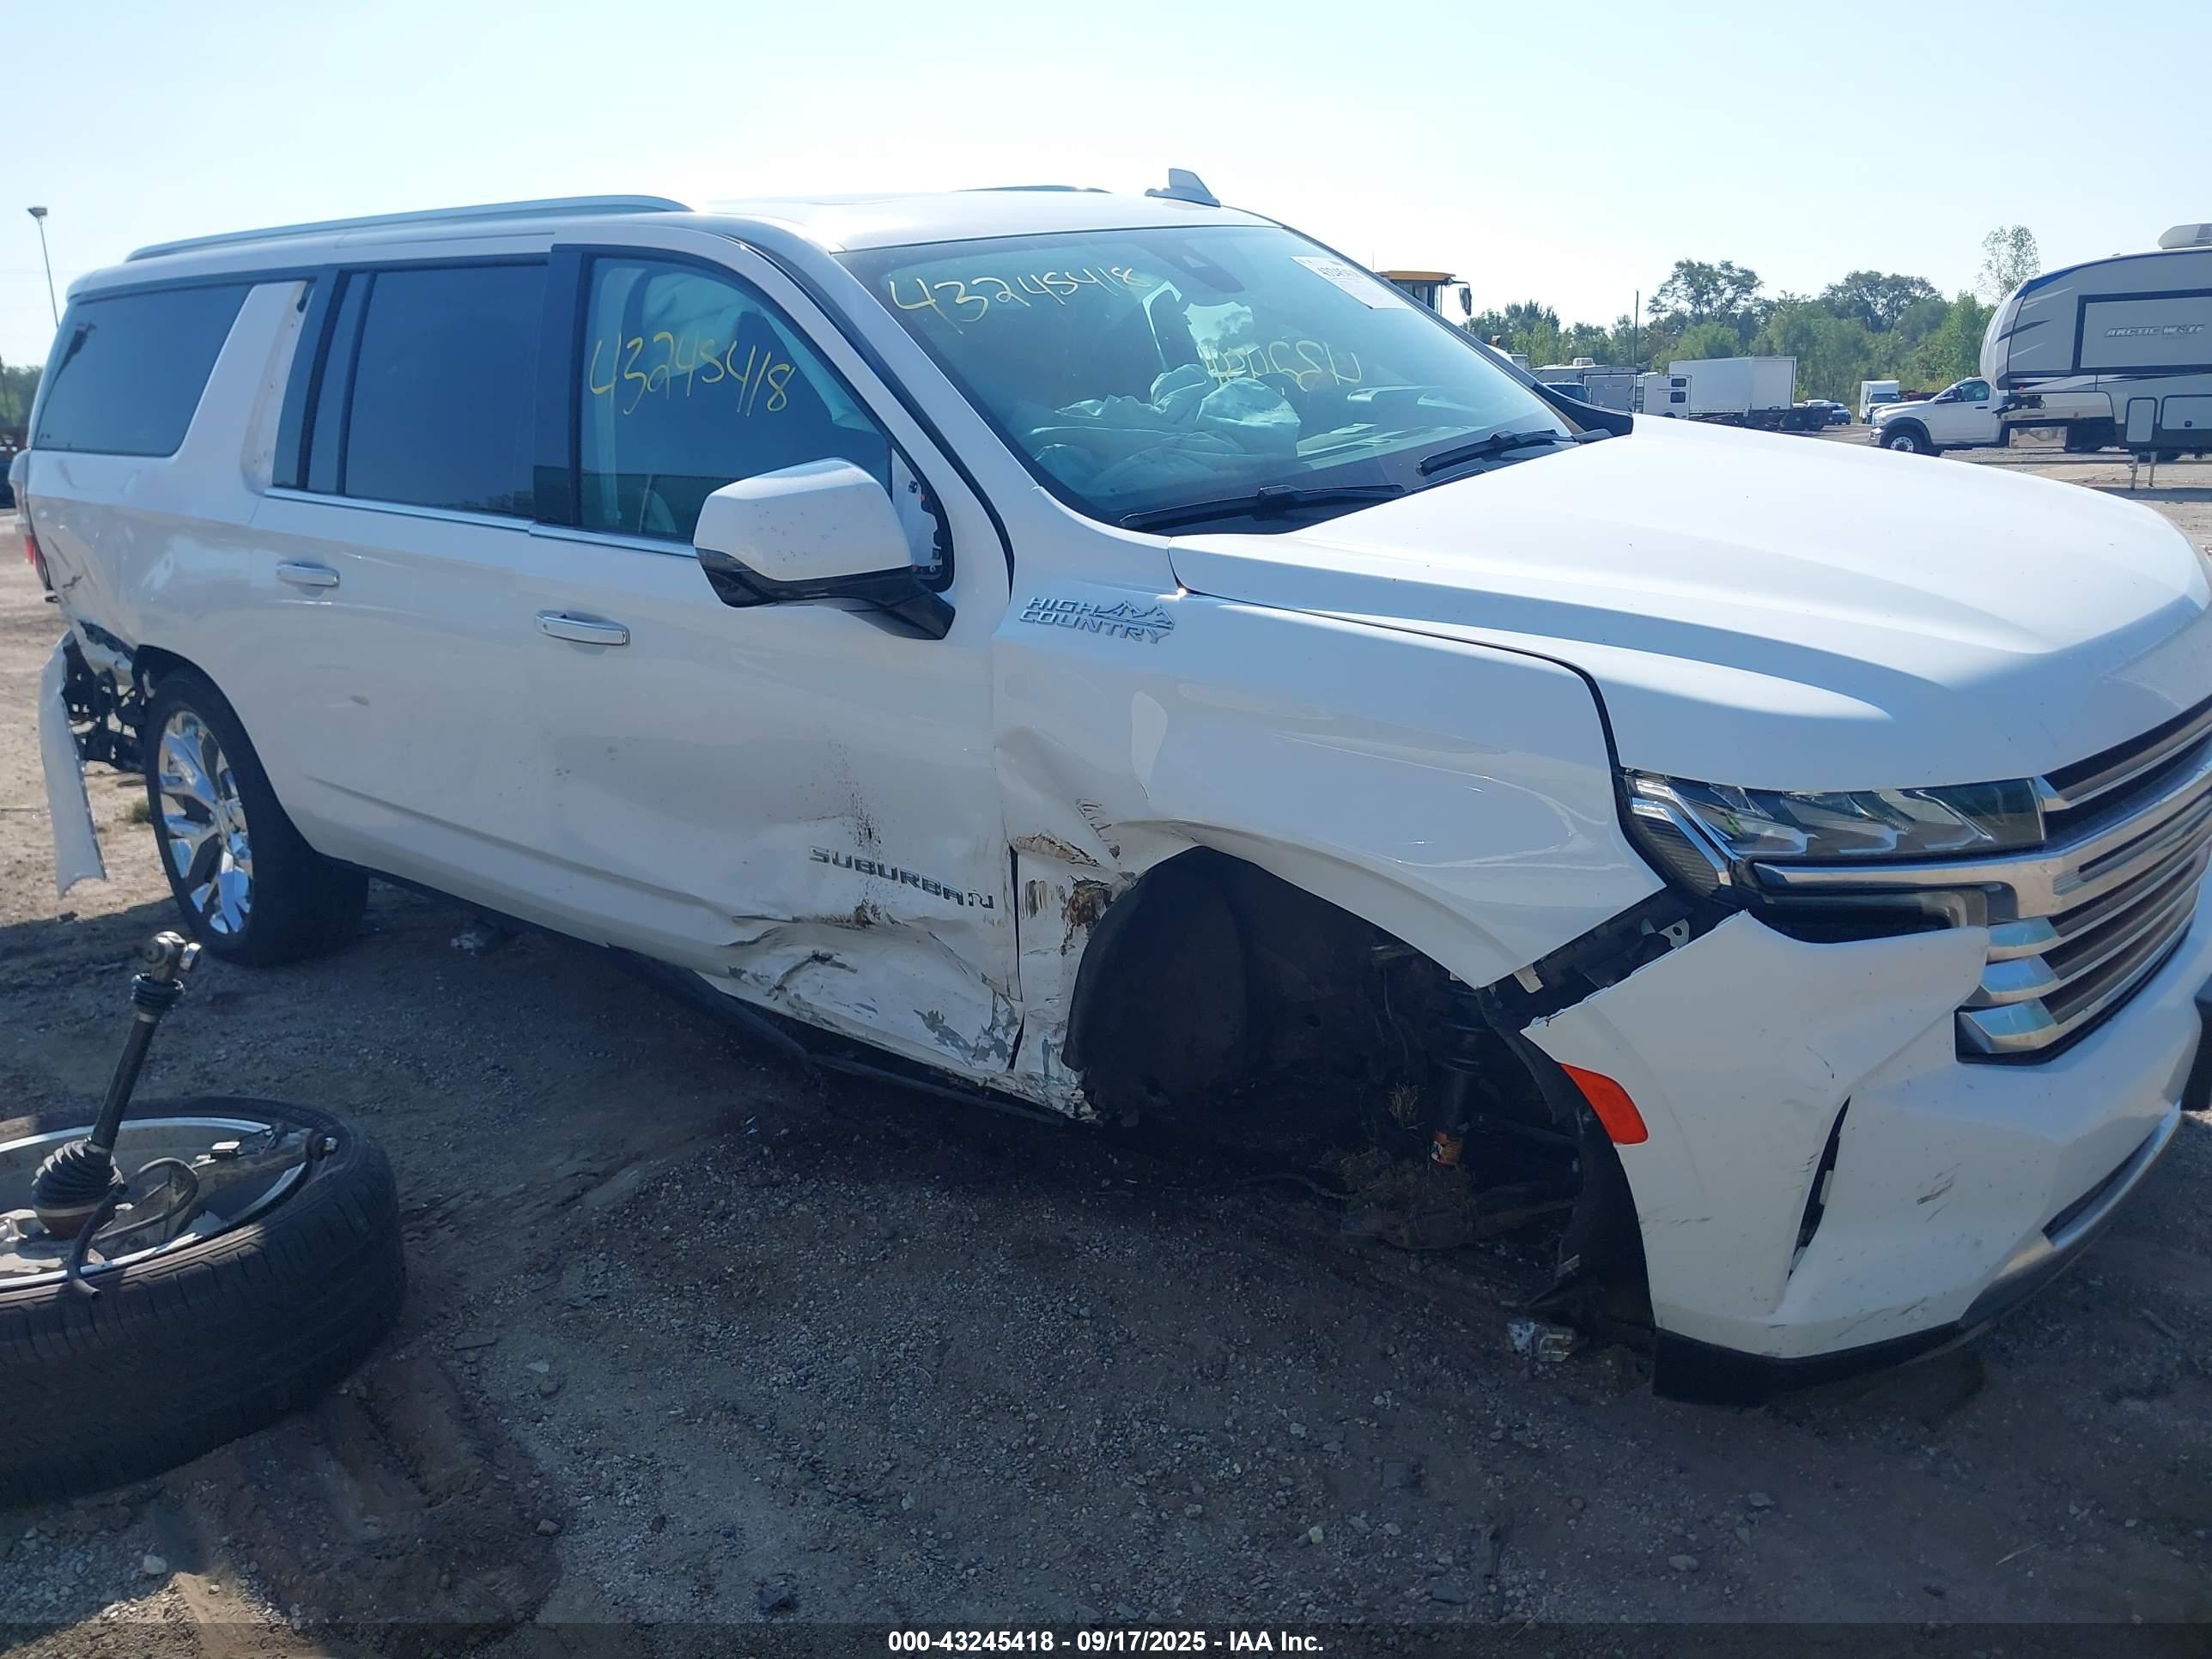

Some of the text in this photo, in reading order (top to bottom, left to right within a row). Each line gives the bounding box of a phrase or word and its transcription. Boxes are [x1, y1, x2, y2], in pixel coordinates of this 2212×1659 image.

[890, 267, 1152, 335] 43245418
[590, 330, 797, 416] 43245418
[1019, 609, 1170, 644] COUNTRY
[1026, 597, 1100, 617] HIGH
[809, 846, 994, 909] SUBURBAN
